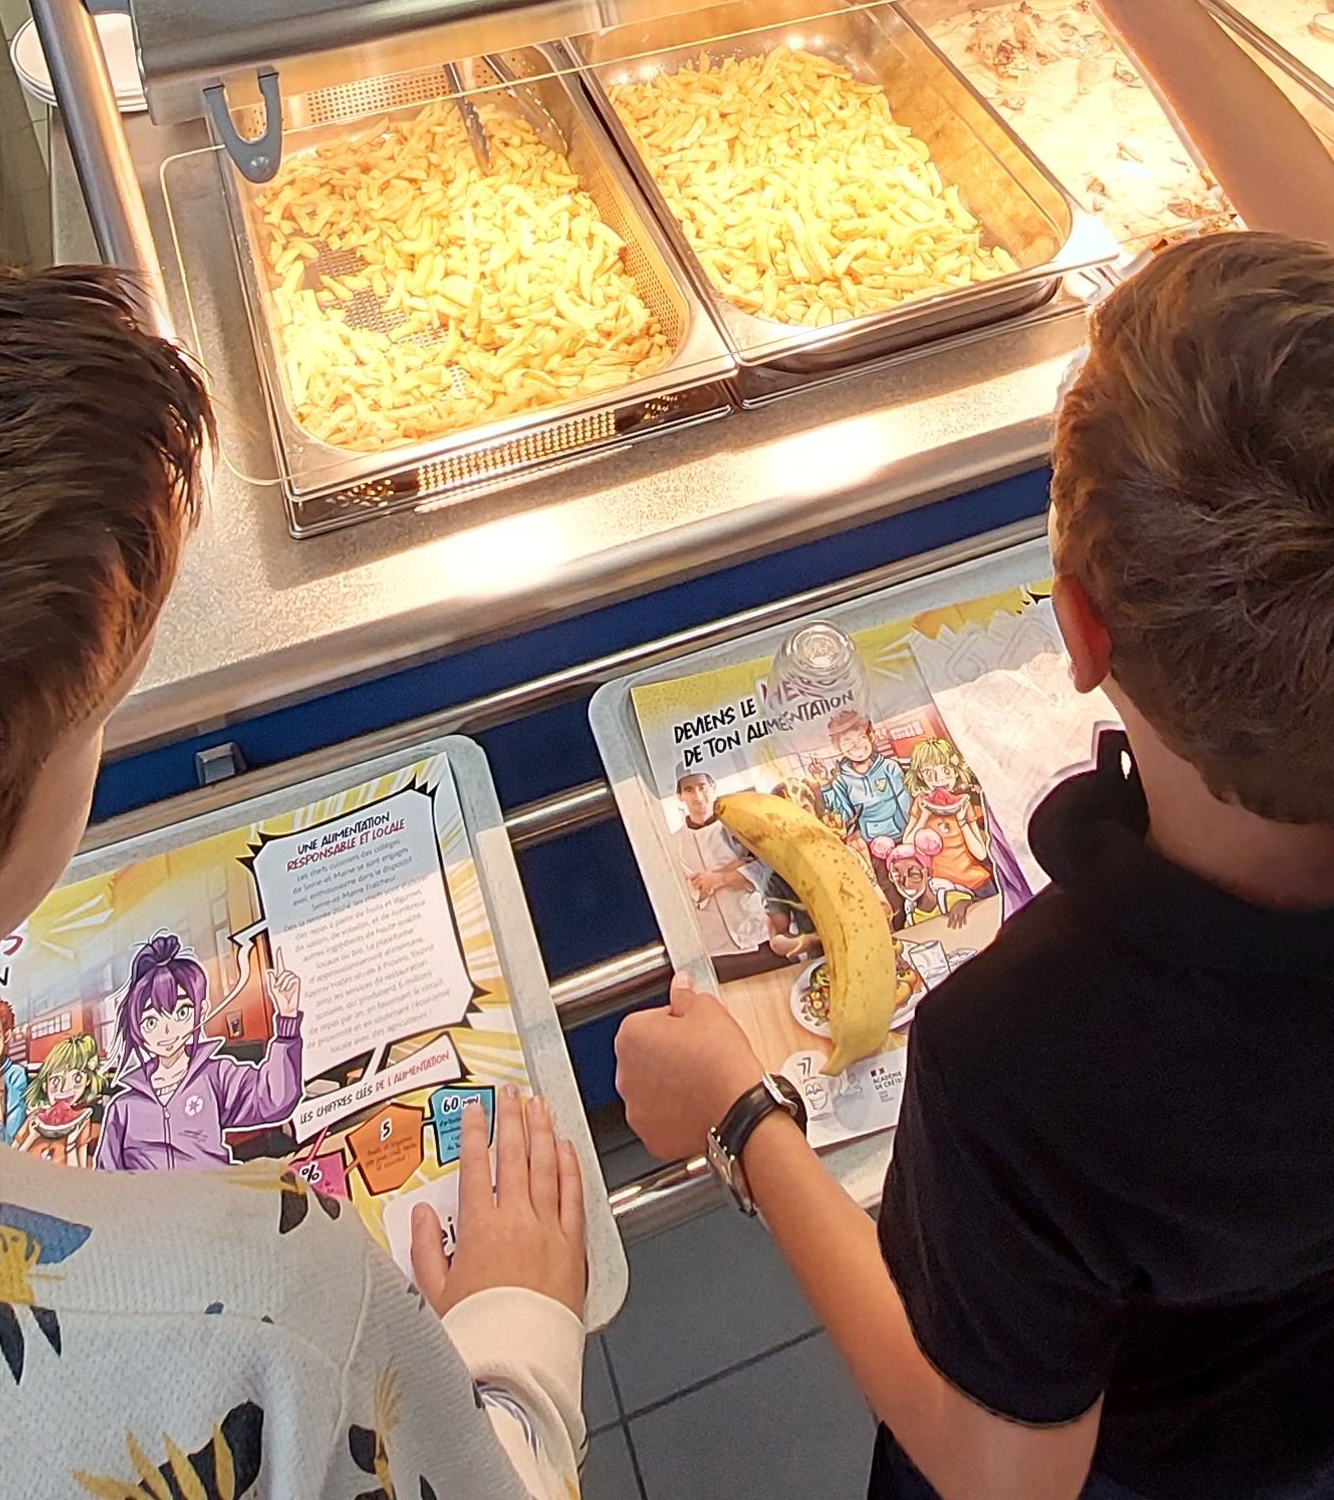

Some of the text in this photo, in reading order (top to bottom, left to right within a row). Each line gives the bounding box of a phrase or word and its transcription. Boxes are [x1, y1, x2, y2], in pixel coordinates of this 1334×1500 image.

[674, 706, 736, 744] DEVIENS
[740, 698, 757, 718] LE
[683, 746, 704, 767] DE
[703, 730, 741, 758] TON
[286, 818, 406, 872] RESPONSABLE ET LOCALE
[297, 811, 390, 855] UNE ALIMENTATION
[300, 1110, 313, 1125] LES
[317, 1094, 353, 1117] CHIFFRES
[356, 1083, 373, 1101] CLÉS
[375, 1080, 386, 1092] DE
[443, 1097, 459, 1113] 60
[382, 1121, 391, 1138] 5
